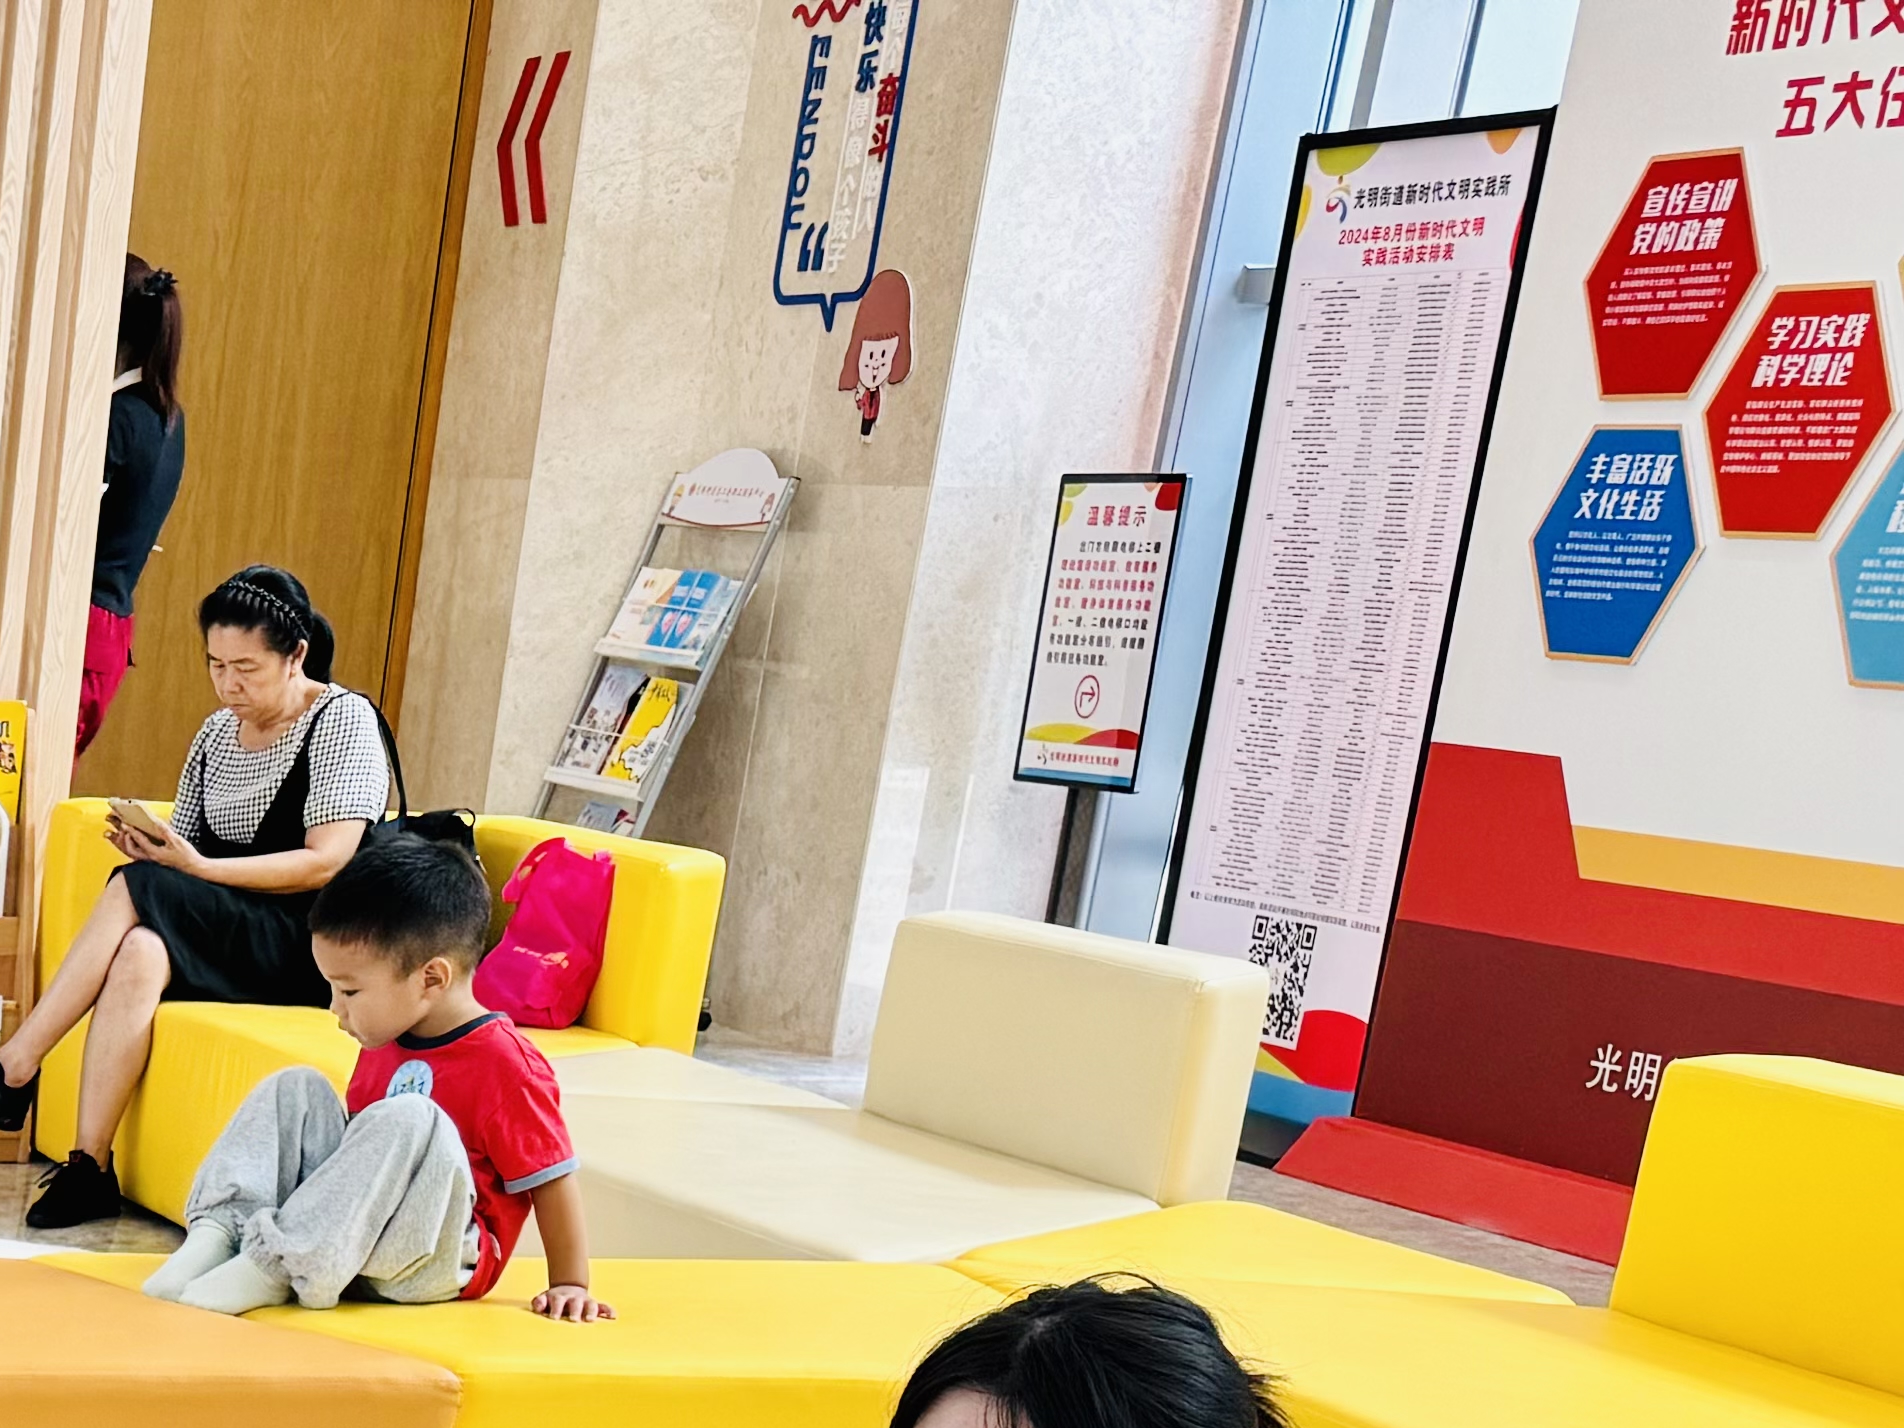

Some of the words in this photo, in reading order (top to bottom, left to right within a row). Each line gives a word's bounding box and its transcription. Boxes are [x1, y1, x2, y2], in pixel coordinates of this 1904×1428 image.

[1353, 174, 1512, 210] 光明街道新时代文明实践所
[1338, 216, 1486, 245] 2024年8月份新时代文明
[1629, 217, 1726, 255] 党的政策
[1361, 243, 1456, 267] 实践活动安排表
[1767, 312, 1871, 350] 学习实践
[1751, 352, 1855, 388] 科学理论
[1585, 453, 1679, 486] 丰富活跃
[1573, 488, 1666, 522] 文化生活
[1585, 1043, 1662, 1101] 光明
